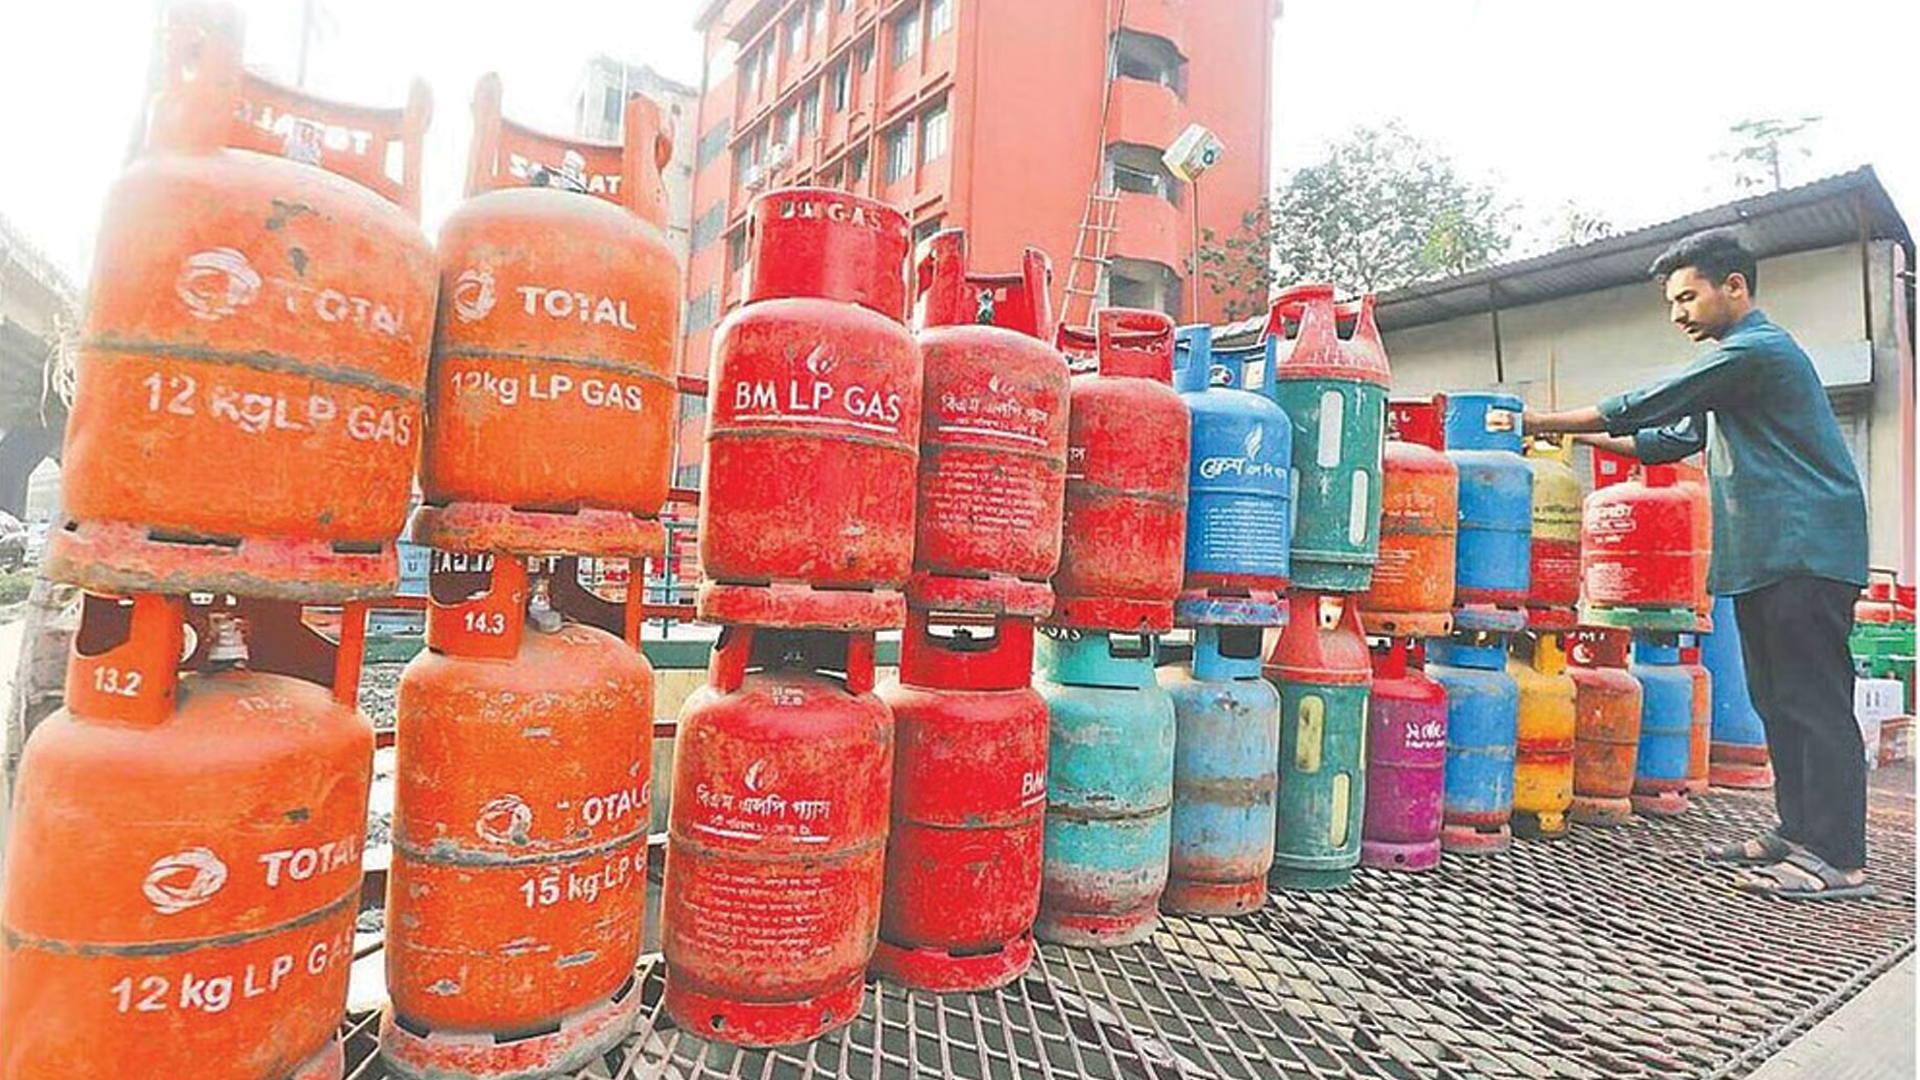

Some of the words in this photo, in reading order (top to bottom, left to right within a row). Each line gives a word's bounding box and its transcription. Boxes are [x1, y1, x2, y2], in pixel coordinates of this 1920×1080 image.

[828, 203, 882, 231] GAS
[271, 278, 412, 344] TOTAL
[516, 285, 637, 332] TOTAL
[144, 372, 197, 416] 12
[348, 406, 411, 446] GAS
[528, 373, 574, 400] LP
[581, 378, 643, 412] GAS
[735, 381, 777, 410] BM
[789, 380, 834, 411] LP
[844, 386, 901, 423] GAS
[465, 612, 506, 634] 14.3
[94, 666, 143, 697] 13.2
[696, 783, 735, 812] বিএম
[739, 793, 788, 819] এলপি
[792, 800, 832, 820] গ্যাস
[259, 834, 359, 888] TOTAL
[519, 874, 560, 909] 15
[568, 873, 602, 903] kg
[604, 855, 630, 889] LP
[110, 976, 170, 1014] 12
[179, 972, 234, 1014] kg
[243, 954, 294, 999] LP
